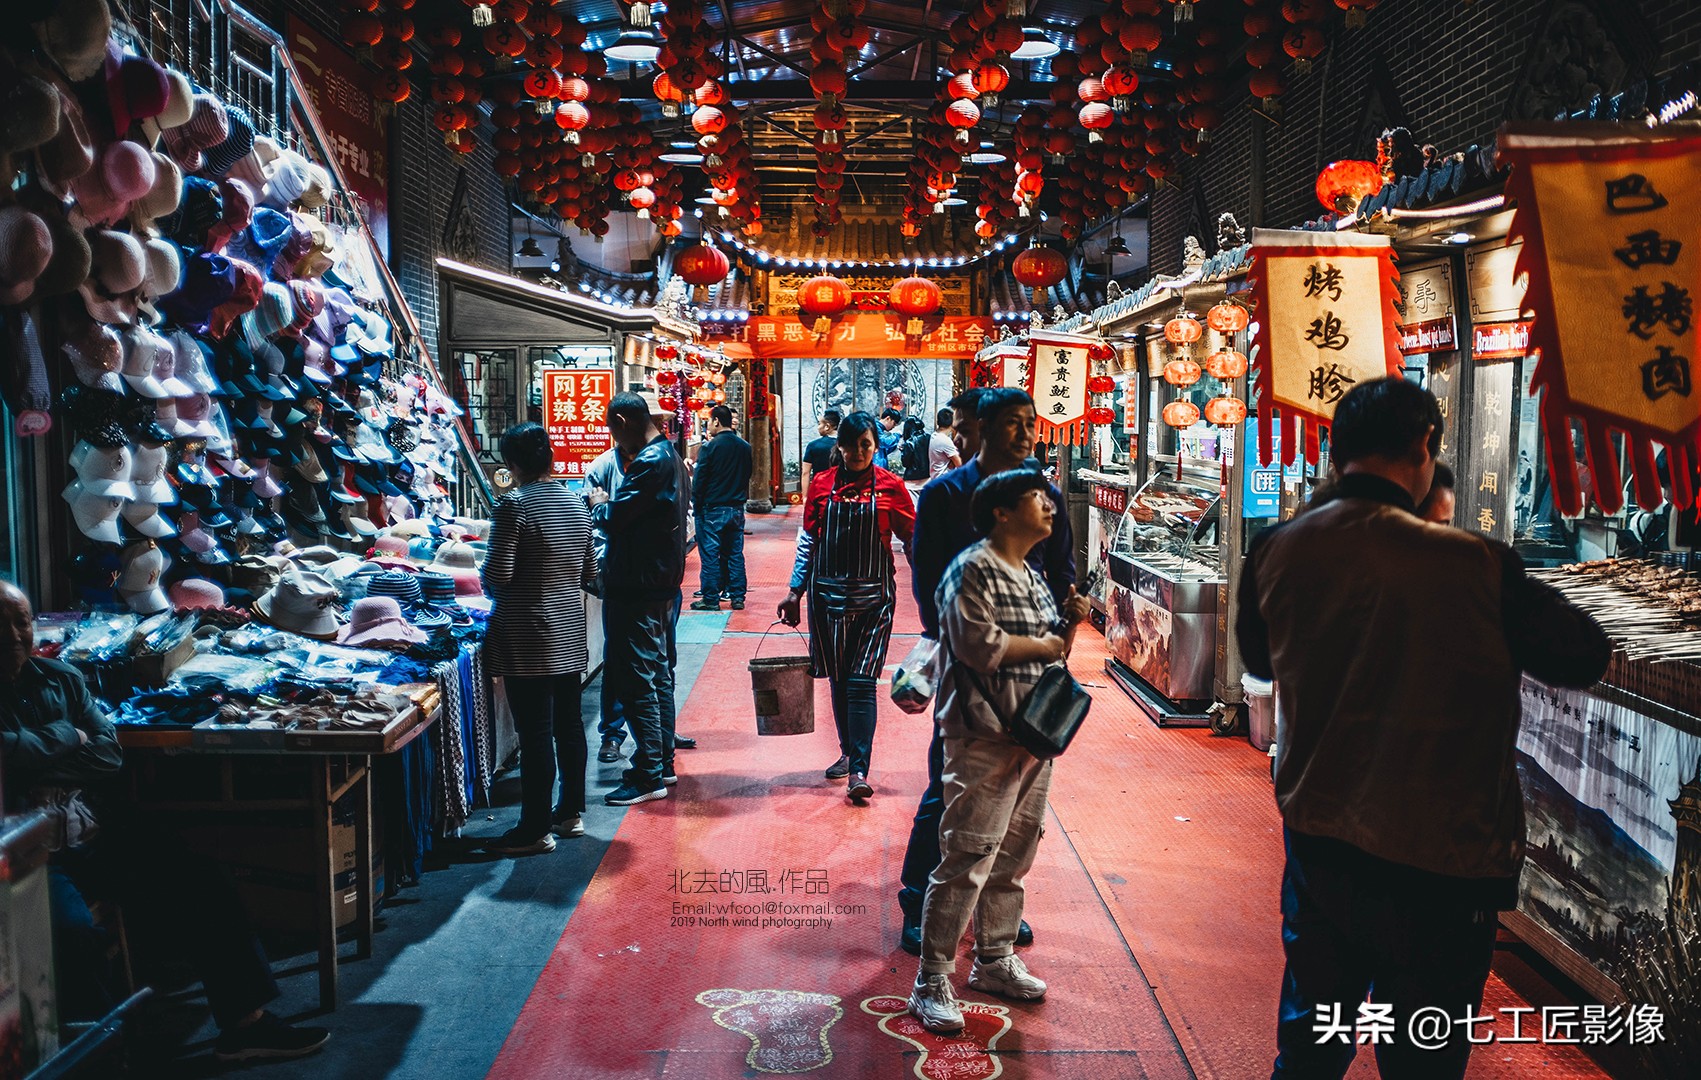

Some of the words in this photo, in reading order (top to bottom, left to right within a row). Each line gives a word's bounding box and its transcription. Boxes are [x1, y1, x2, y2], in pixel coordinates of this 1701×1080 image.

[1605, 174, 1693, 401] 巴西烤肉
[1303, 262, 1356, 405] 烤鸡胗
[1510, 322, 1529, 349] Barb
[553, 374, 605, 398] 网红
[1049, 349, 1071, 416] 富贵鱿鱼
[552, 398, 606, 422] 辣条
